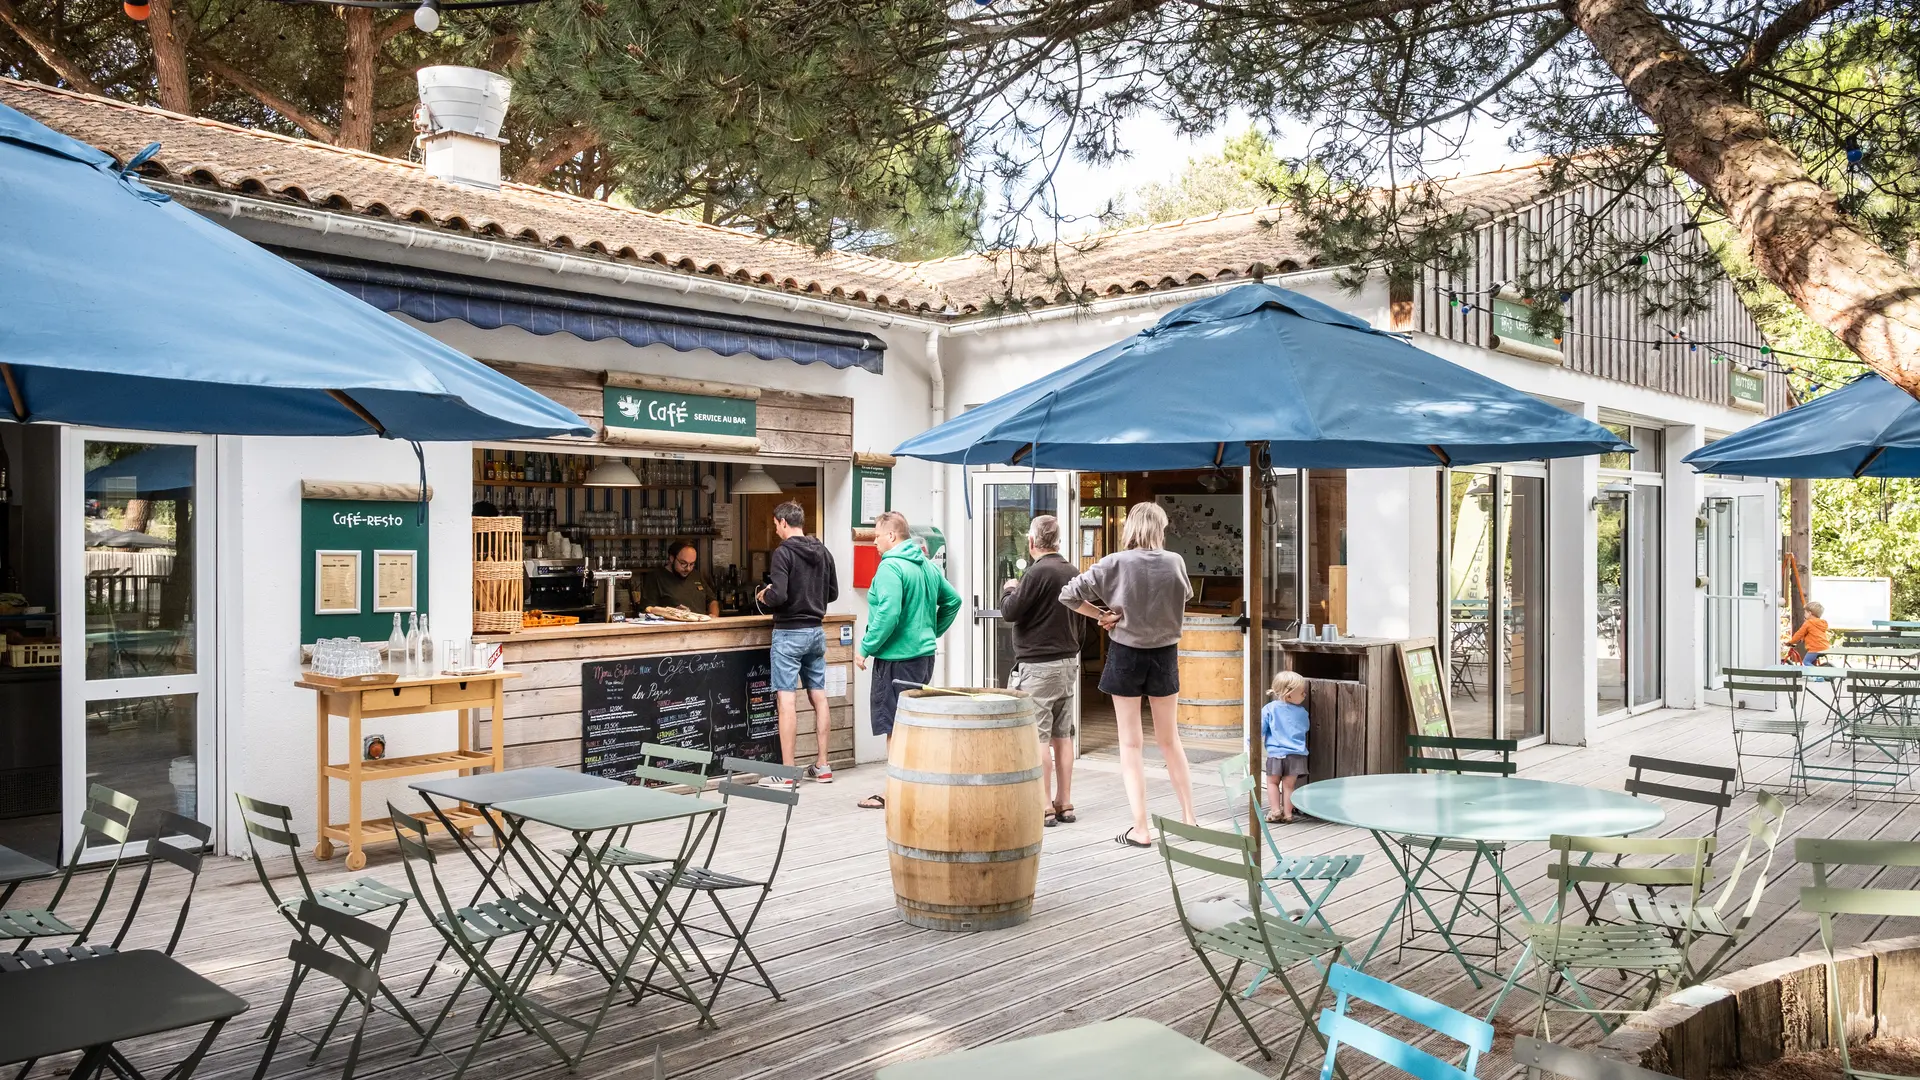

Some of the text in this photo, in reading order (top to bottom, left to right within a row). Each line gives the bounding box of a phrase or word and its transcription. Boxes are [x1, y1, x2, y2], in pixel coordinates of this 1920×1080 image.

[694, 413, 722, 423] SERVICE
[722, 415, 732, 424] AU
[733, 416, 747, 425] BAR
